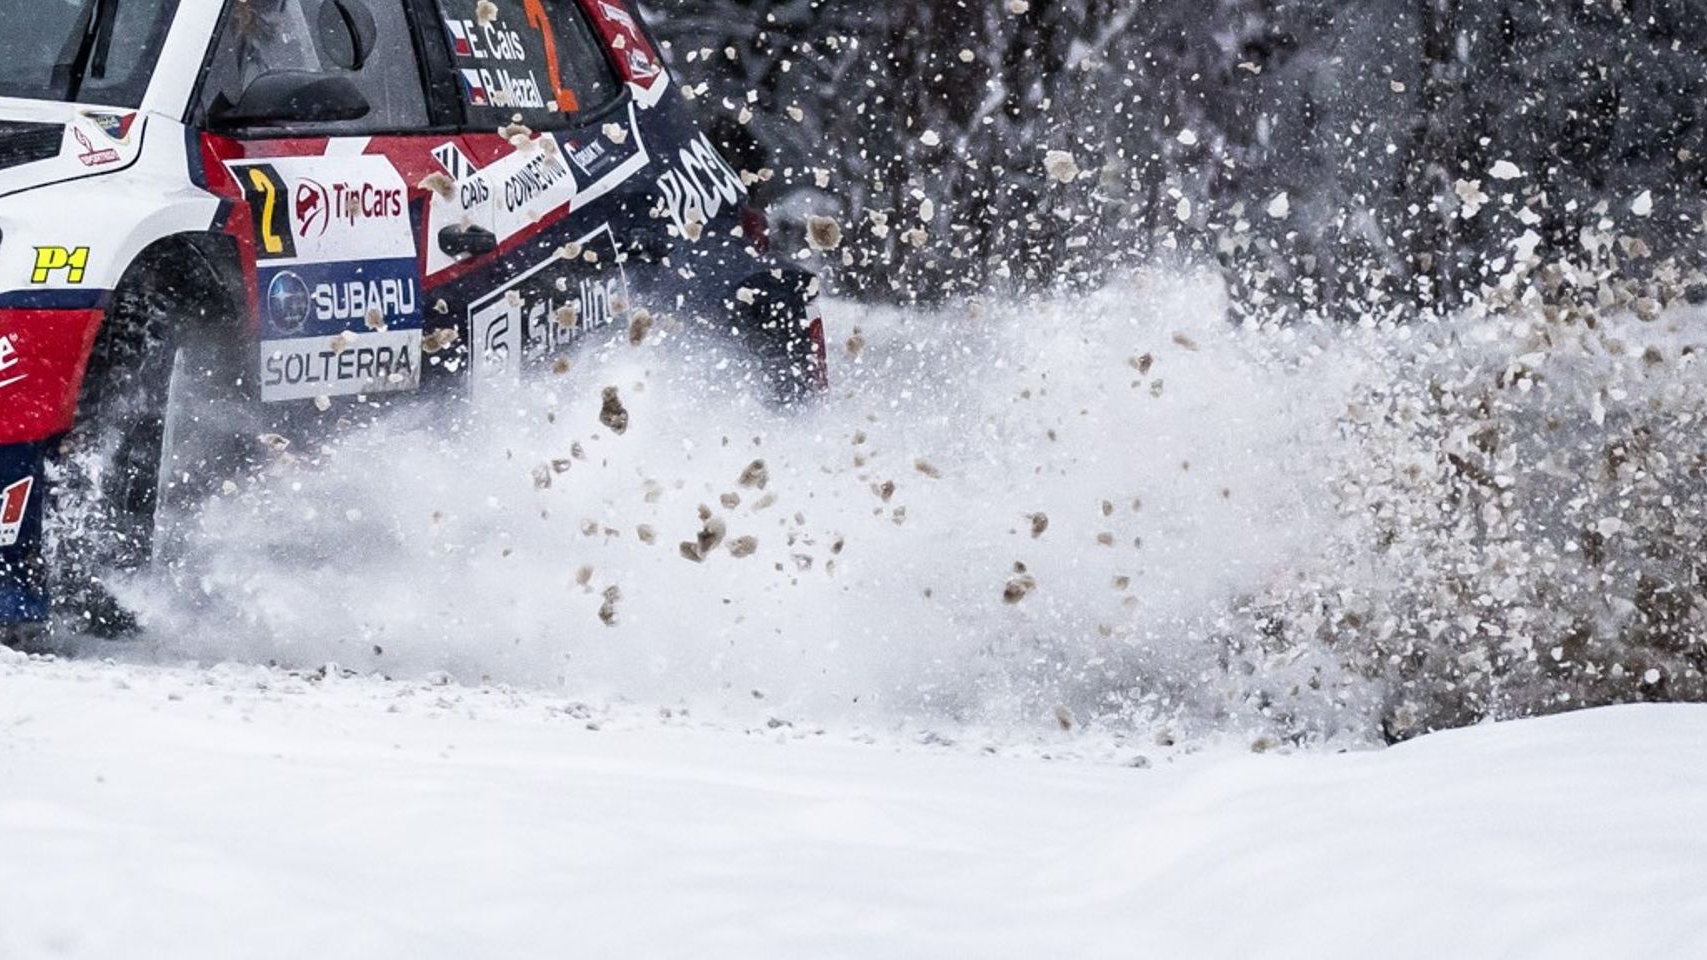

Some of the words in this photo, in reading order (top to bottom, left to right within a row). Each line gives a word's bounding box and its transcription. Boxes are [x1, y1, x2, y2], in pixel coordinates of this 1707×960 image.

[484, 19, 525, 60] Cais
[248, 168, 284, 253] 2
[333, 181, 401, 227] TipCars
[460, 177, 490, 210] CAIS
[31, 245, 90, 284] P1
[315, 278, 415, 321] SUBARU
[264, 345, 413, 387] SOLTERRA
